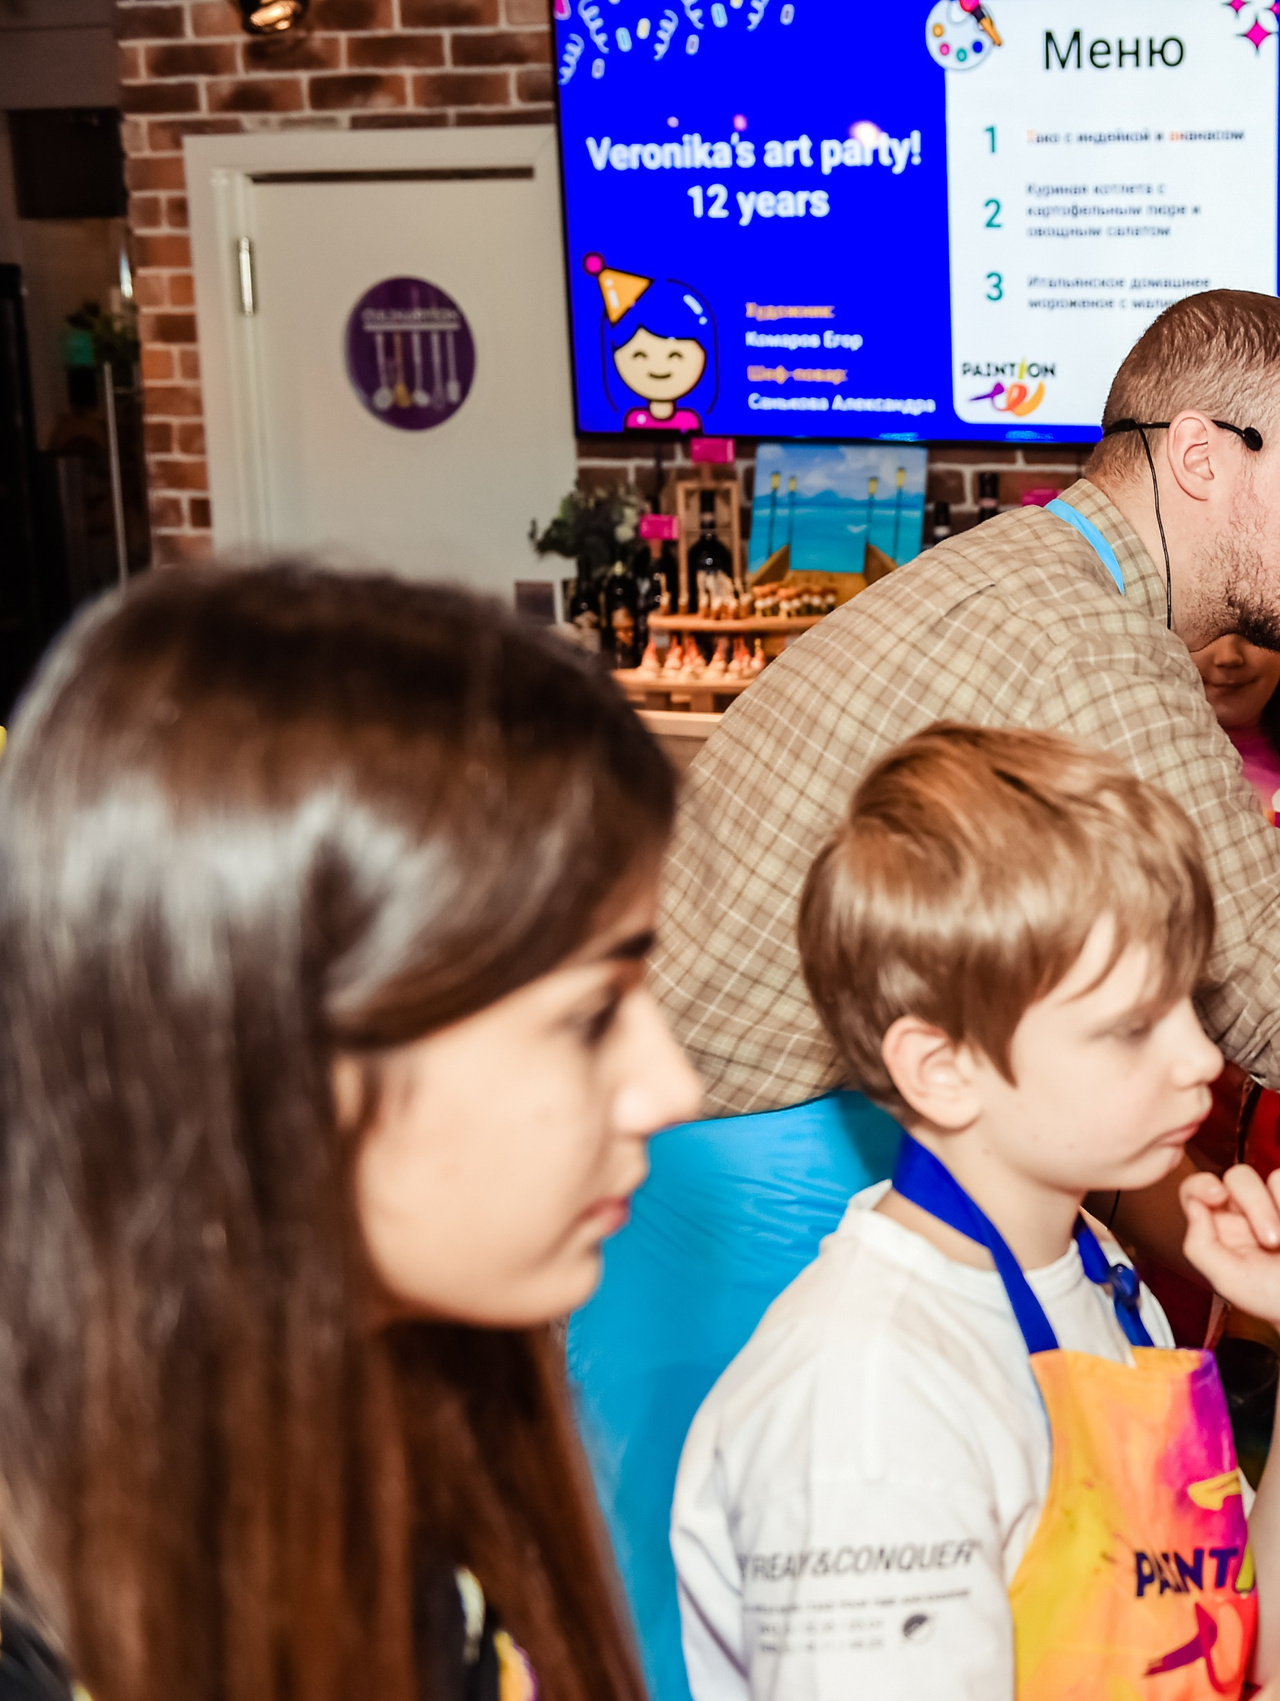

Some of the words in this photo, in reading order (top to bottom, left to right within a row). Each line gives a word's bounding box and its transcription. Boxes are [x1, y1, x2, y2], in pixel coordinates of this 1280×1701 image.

[1044, 30, 1184, 69] Меню
[586, 132, 756, 170] Veronika's
[764, 134, 813, 168] art
[820, 129, 922, 175] party!
[984, 125, 996, 153] 1
[687, 183, 729, 218] 12
[736, 189, 830, 226] years
[983, 199, 1002, 228] 2
[985, 271, 1003, 300] 3
